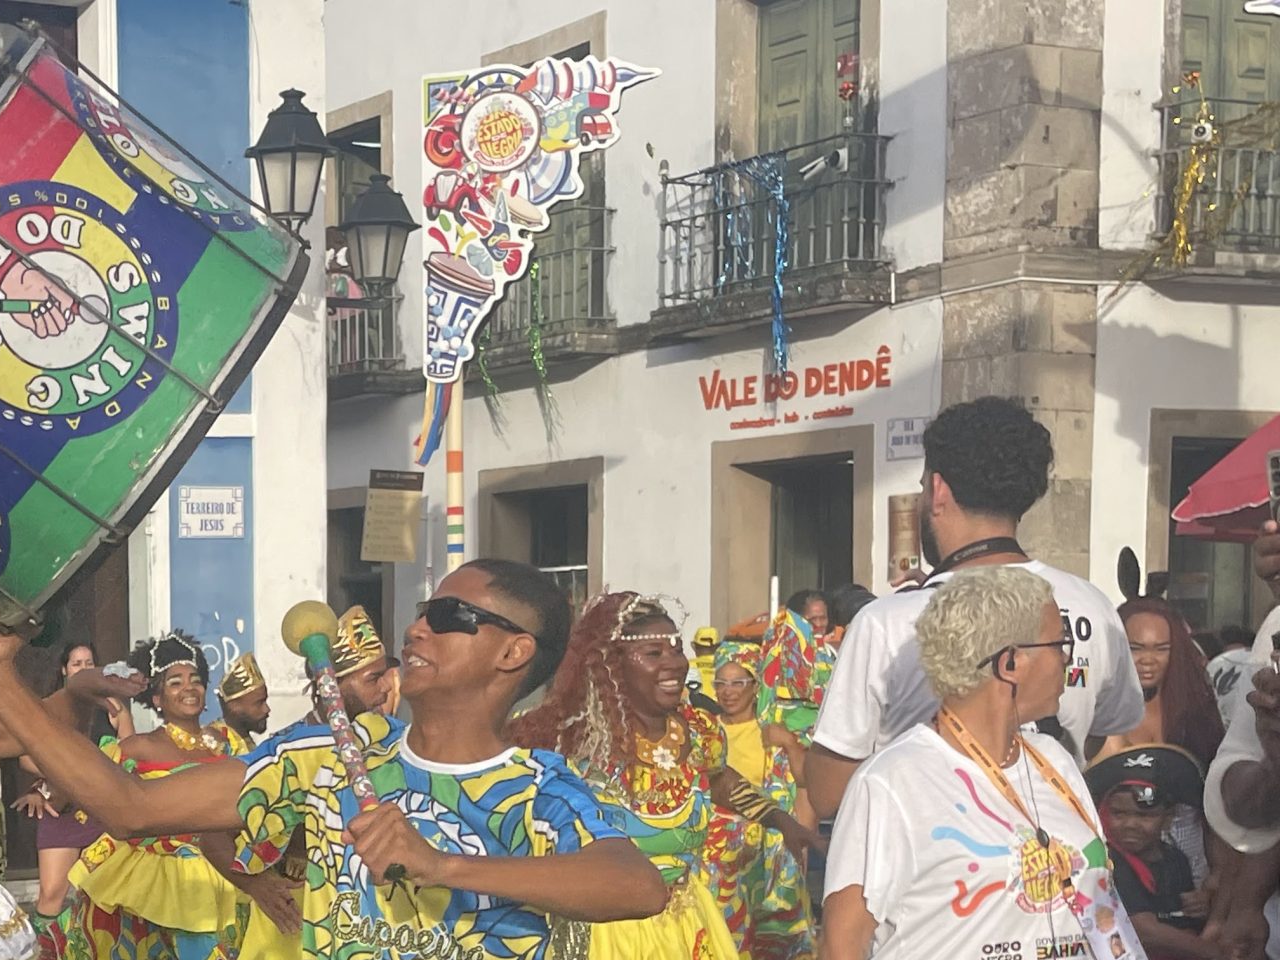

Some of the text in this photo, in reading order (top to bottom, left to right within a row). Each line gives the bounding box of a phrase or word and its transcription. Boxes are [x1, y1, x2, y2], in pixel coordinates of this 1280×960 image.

[479, 115, 523, 140] ESTADO
[34, 190, 106, 219] 100%
[17, 212, 86, 248] DO
[26, 261, 150, 410] SWING
[66, 296, 171, 432] BANDA
[699, 345, 891, 411] VALE DO DENDÊ
[186, 502, 237, 515] TERREIRO DE
[200, 519, 225, 531] JESUS
[982, 941, 1022, 954] OURO
